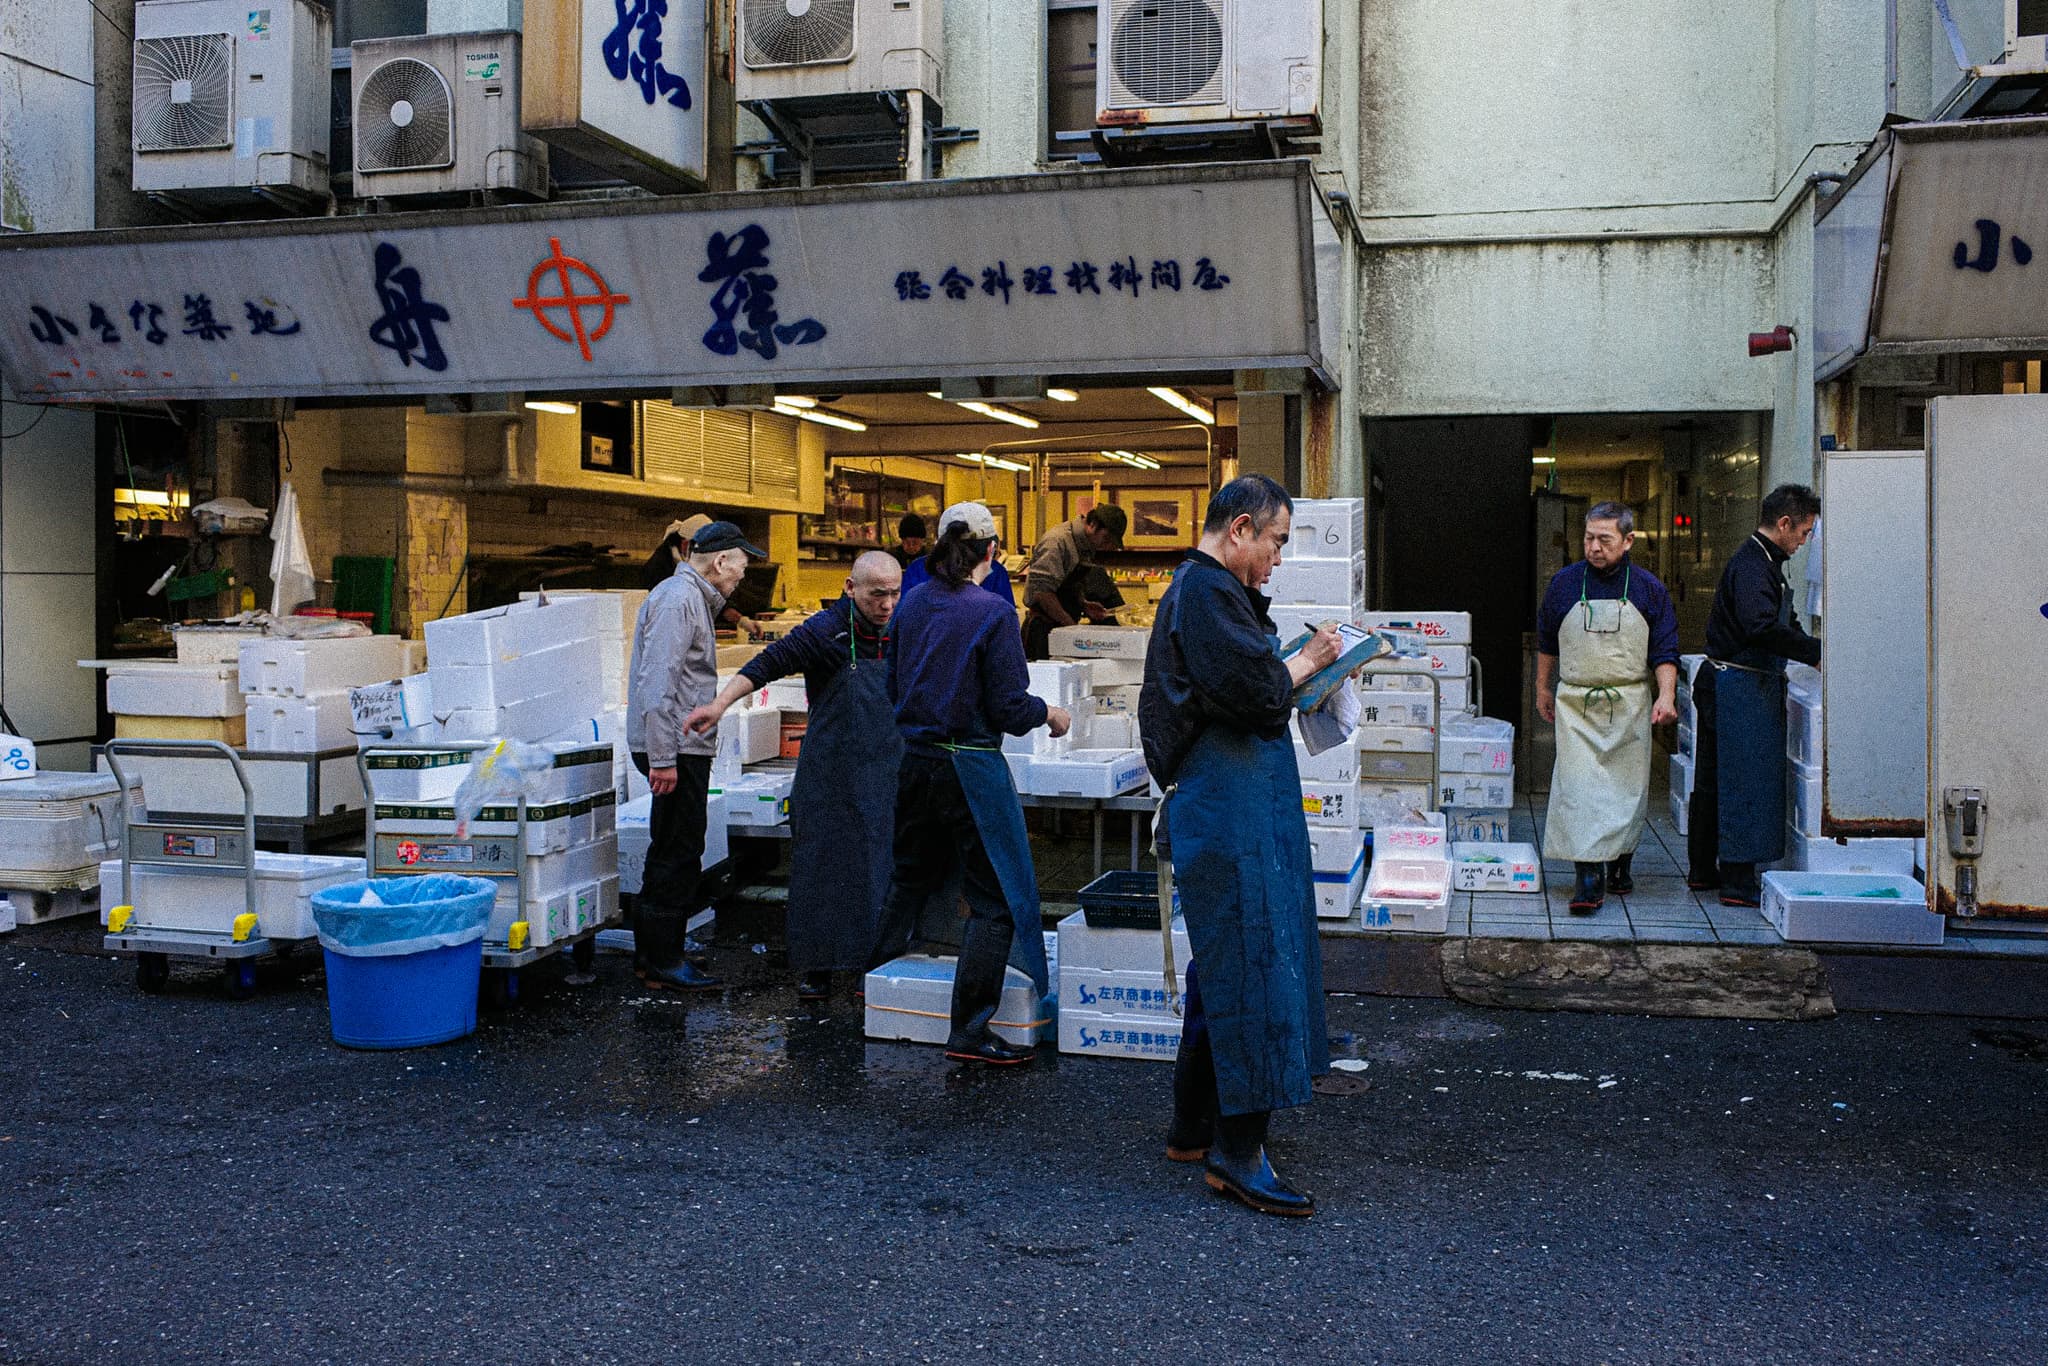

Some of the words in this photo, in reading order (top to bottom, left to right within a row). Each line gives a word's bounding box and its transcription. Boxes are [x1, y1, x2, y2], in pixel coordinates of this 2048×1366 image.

[465, 52, 499, 61] TOSHIBA
[1953, 219, 2032, 273] 小
[1325, 523, 1340, 545] 6
[1365, 706, 1379, 722] 背
[1442, 787, 1456, 804] 背
[1125, 1045, 1137, 1053] TEL
